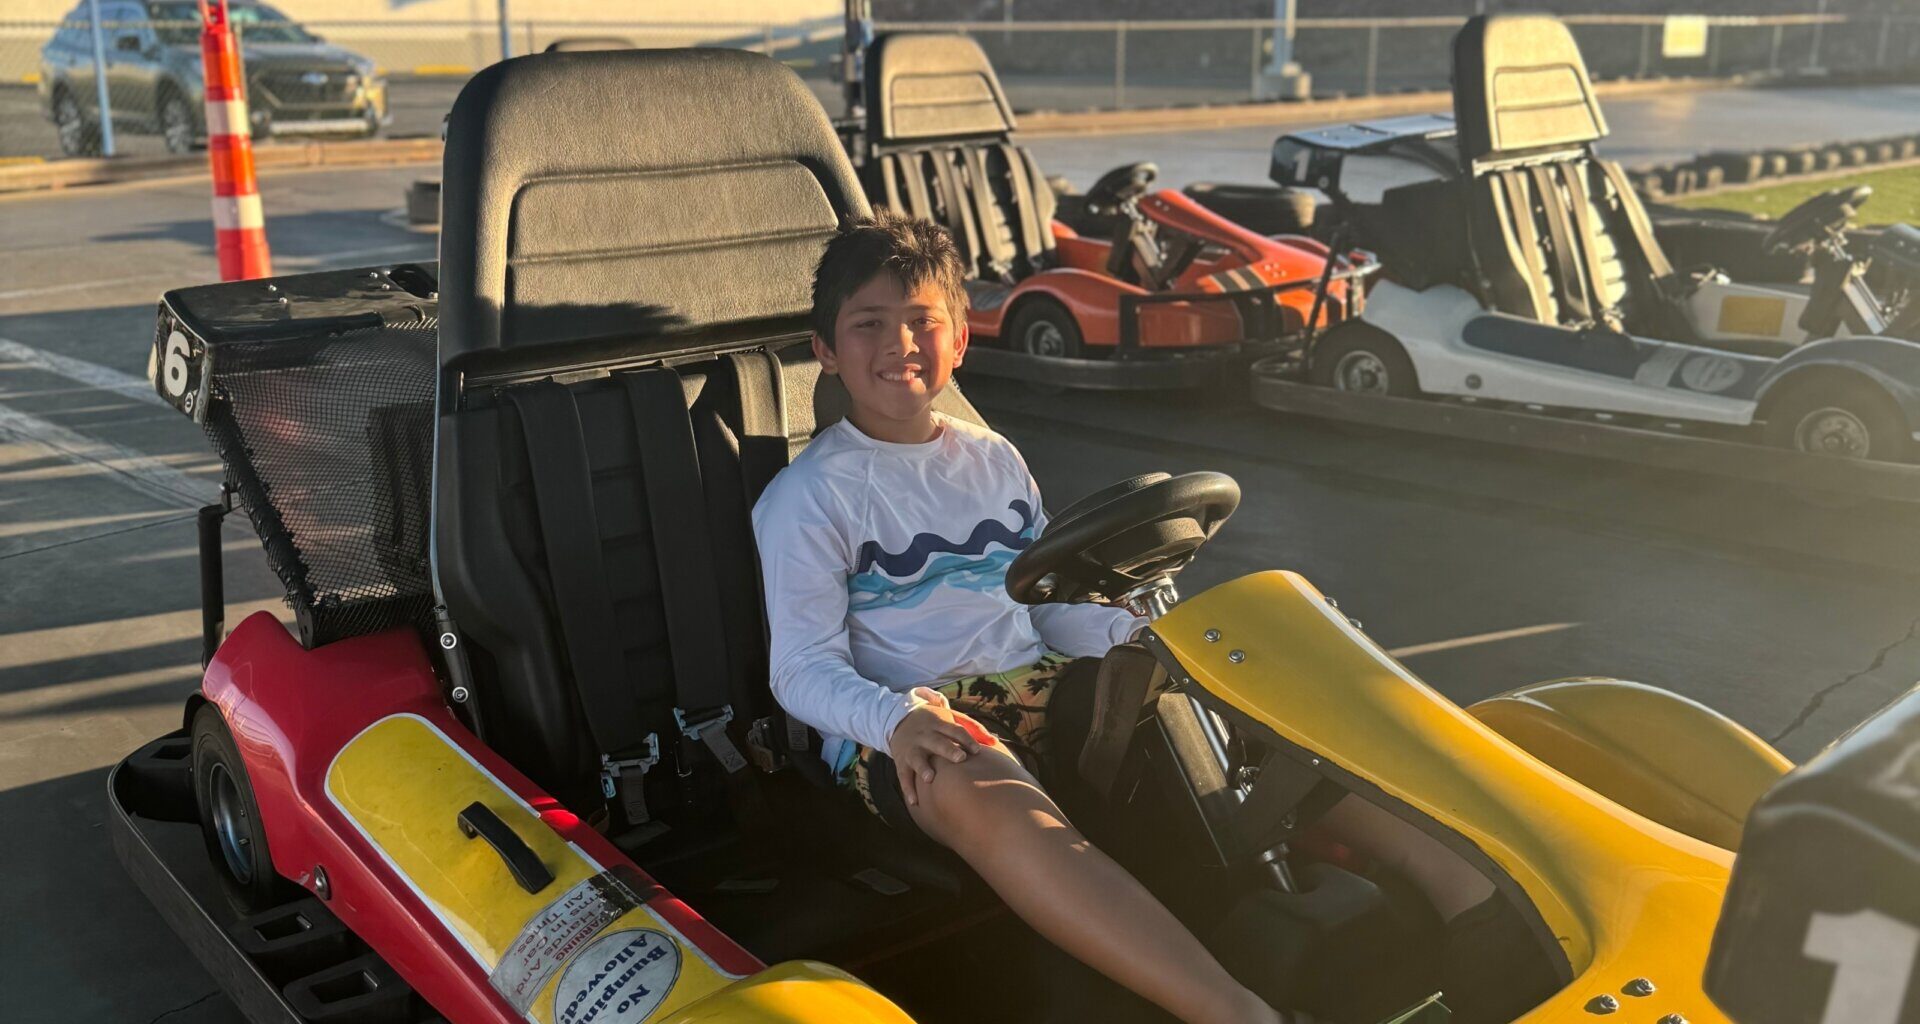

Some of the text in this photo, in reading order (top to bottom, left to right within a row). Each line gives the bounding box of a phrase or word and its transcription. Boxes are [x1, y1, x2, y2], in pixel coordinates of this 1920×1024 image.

[1294, 147, 1311, 182] 1
[164, 331, 190, 397] 6
[523, 893, 600, 966] rms In Car
[563, 891, 584, 909] All
[515, 911, 595, 996] Hands And
[560, 933, 649, 1024] Allowed!
[1803, 908, 1920, 1024] 1
[617, 983, 651, 1014] No
